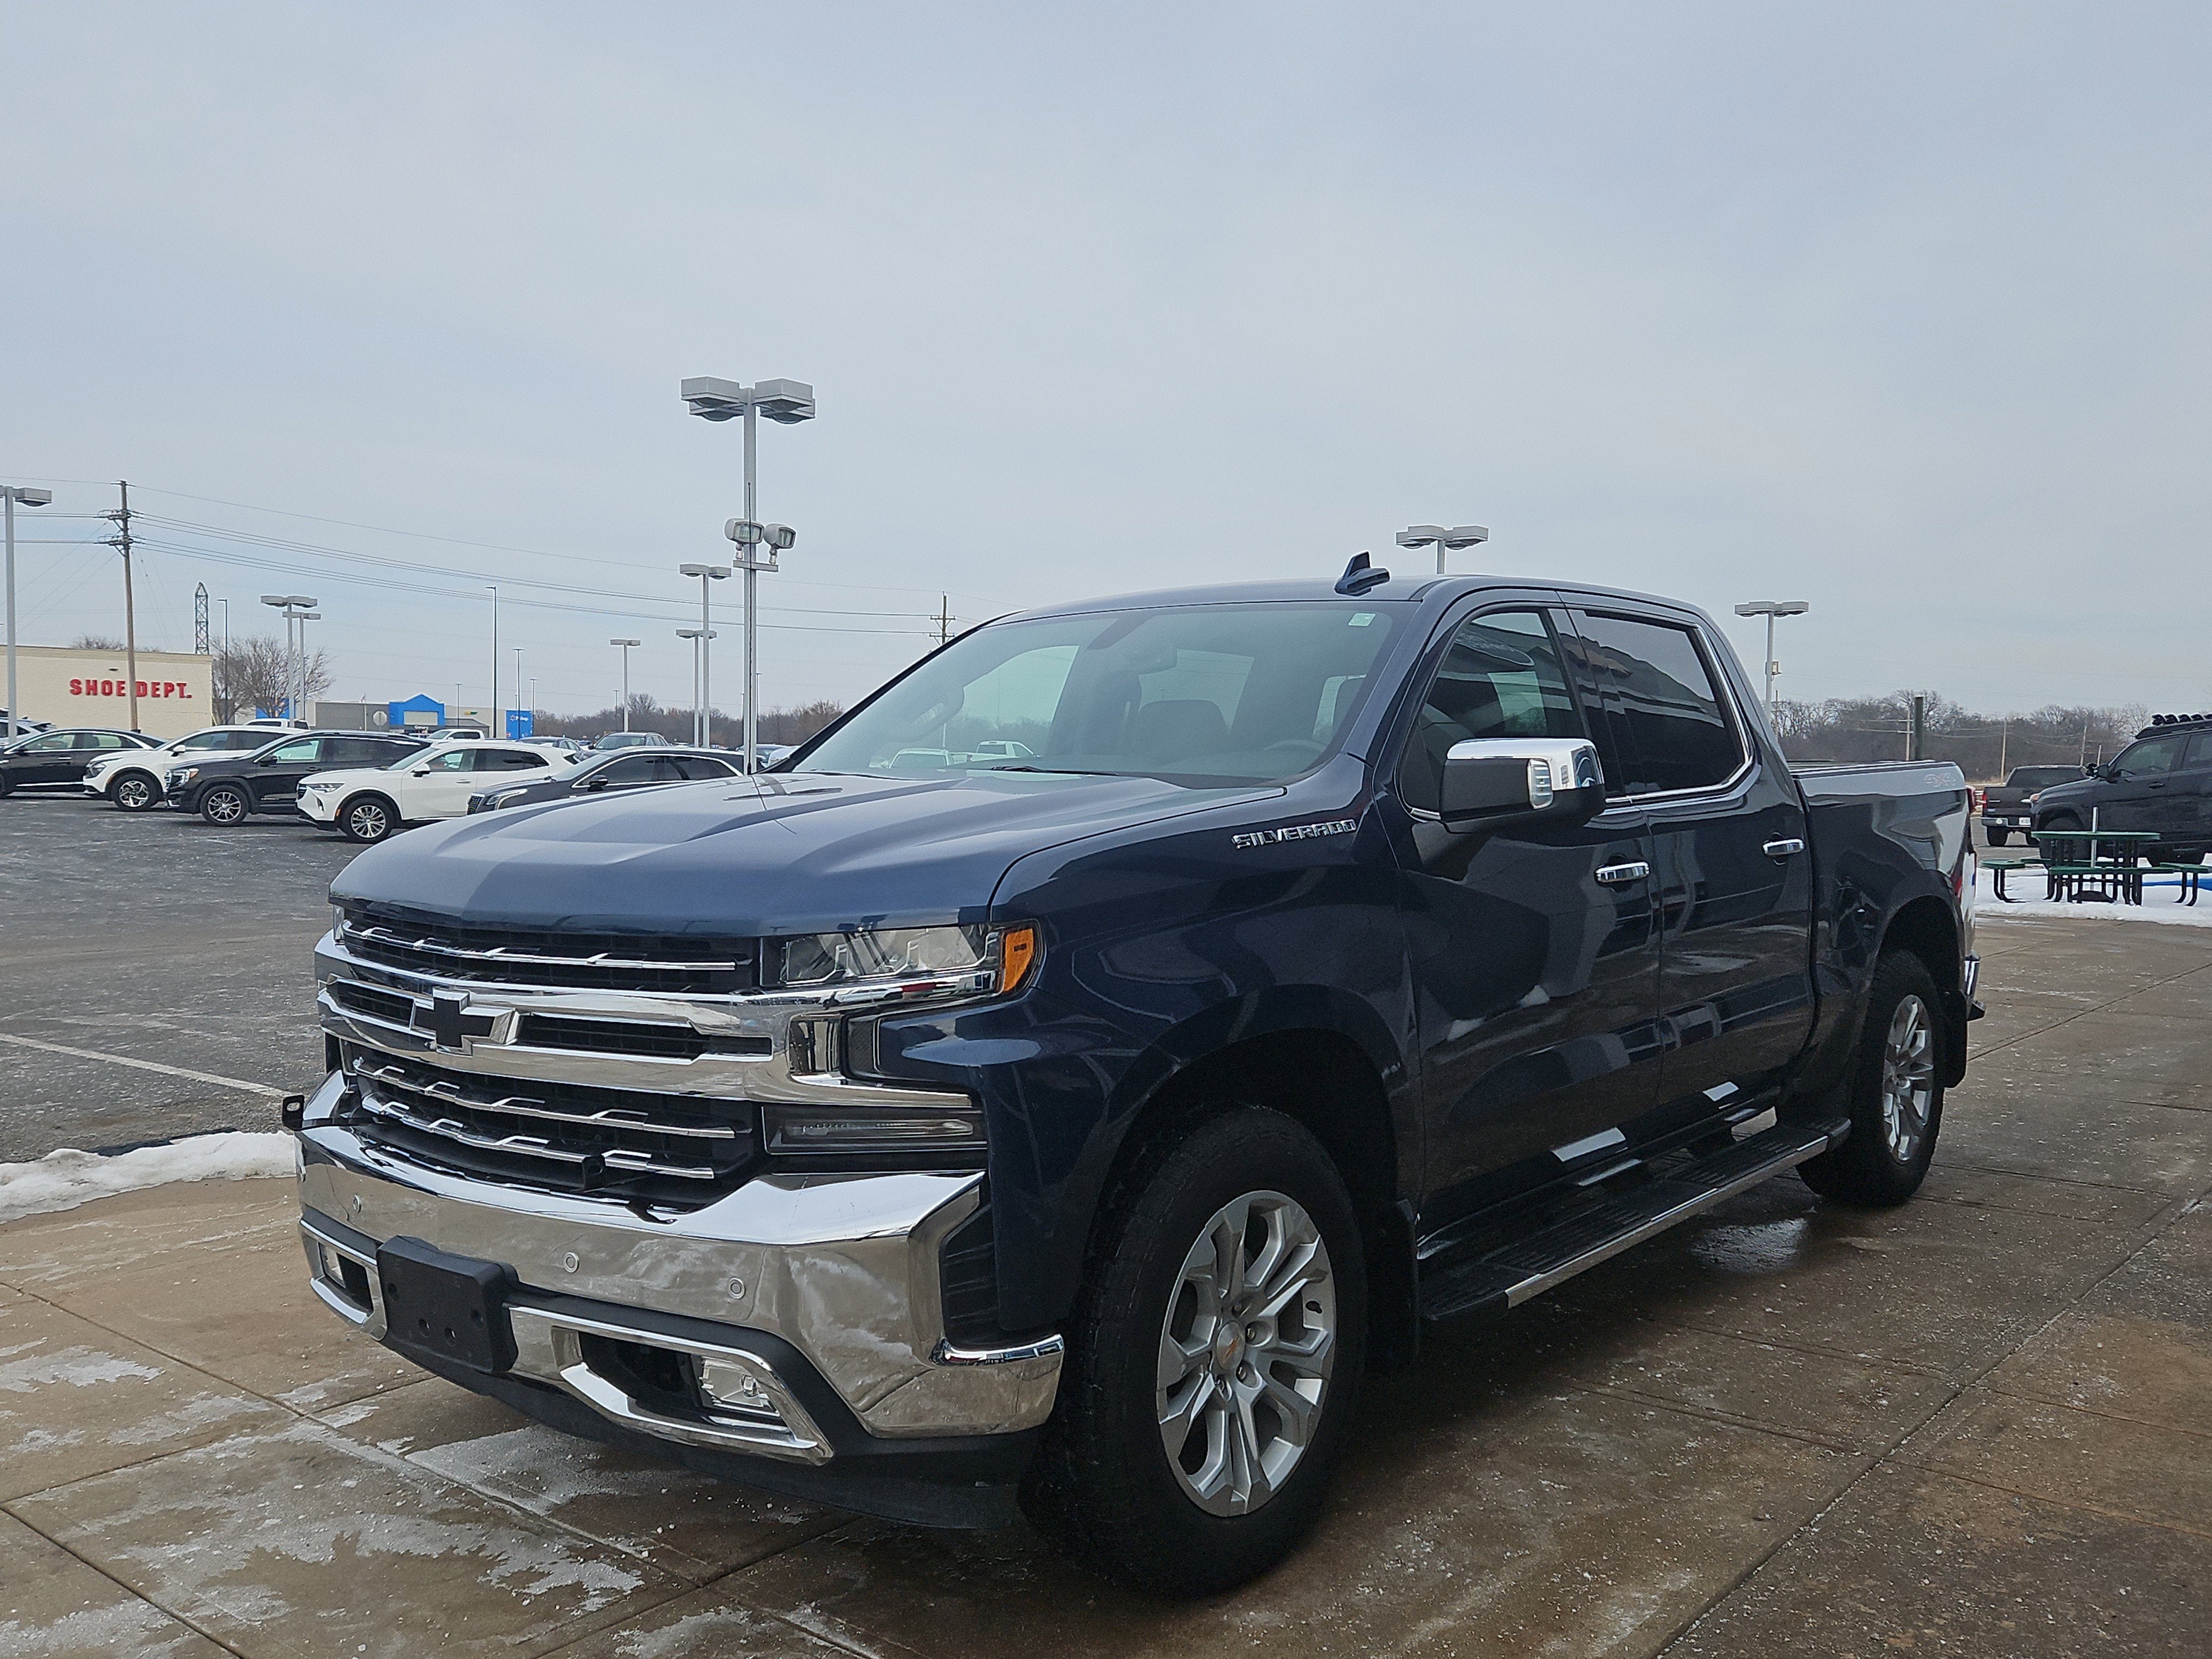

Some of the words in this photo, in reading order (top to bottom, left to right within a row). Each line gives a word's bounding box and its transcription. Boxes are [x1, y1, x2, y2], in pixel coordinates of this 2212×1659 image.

[70, 679, 125, 696] SHOE
[136, 681, 192, 698] DEPT.
[1231, 819, 1356, 850] SILVERADO
